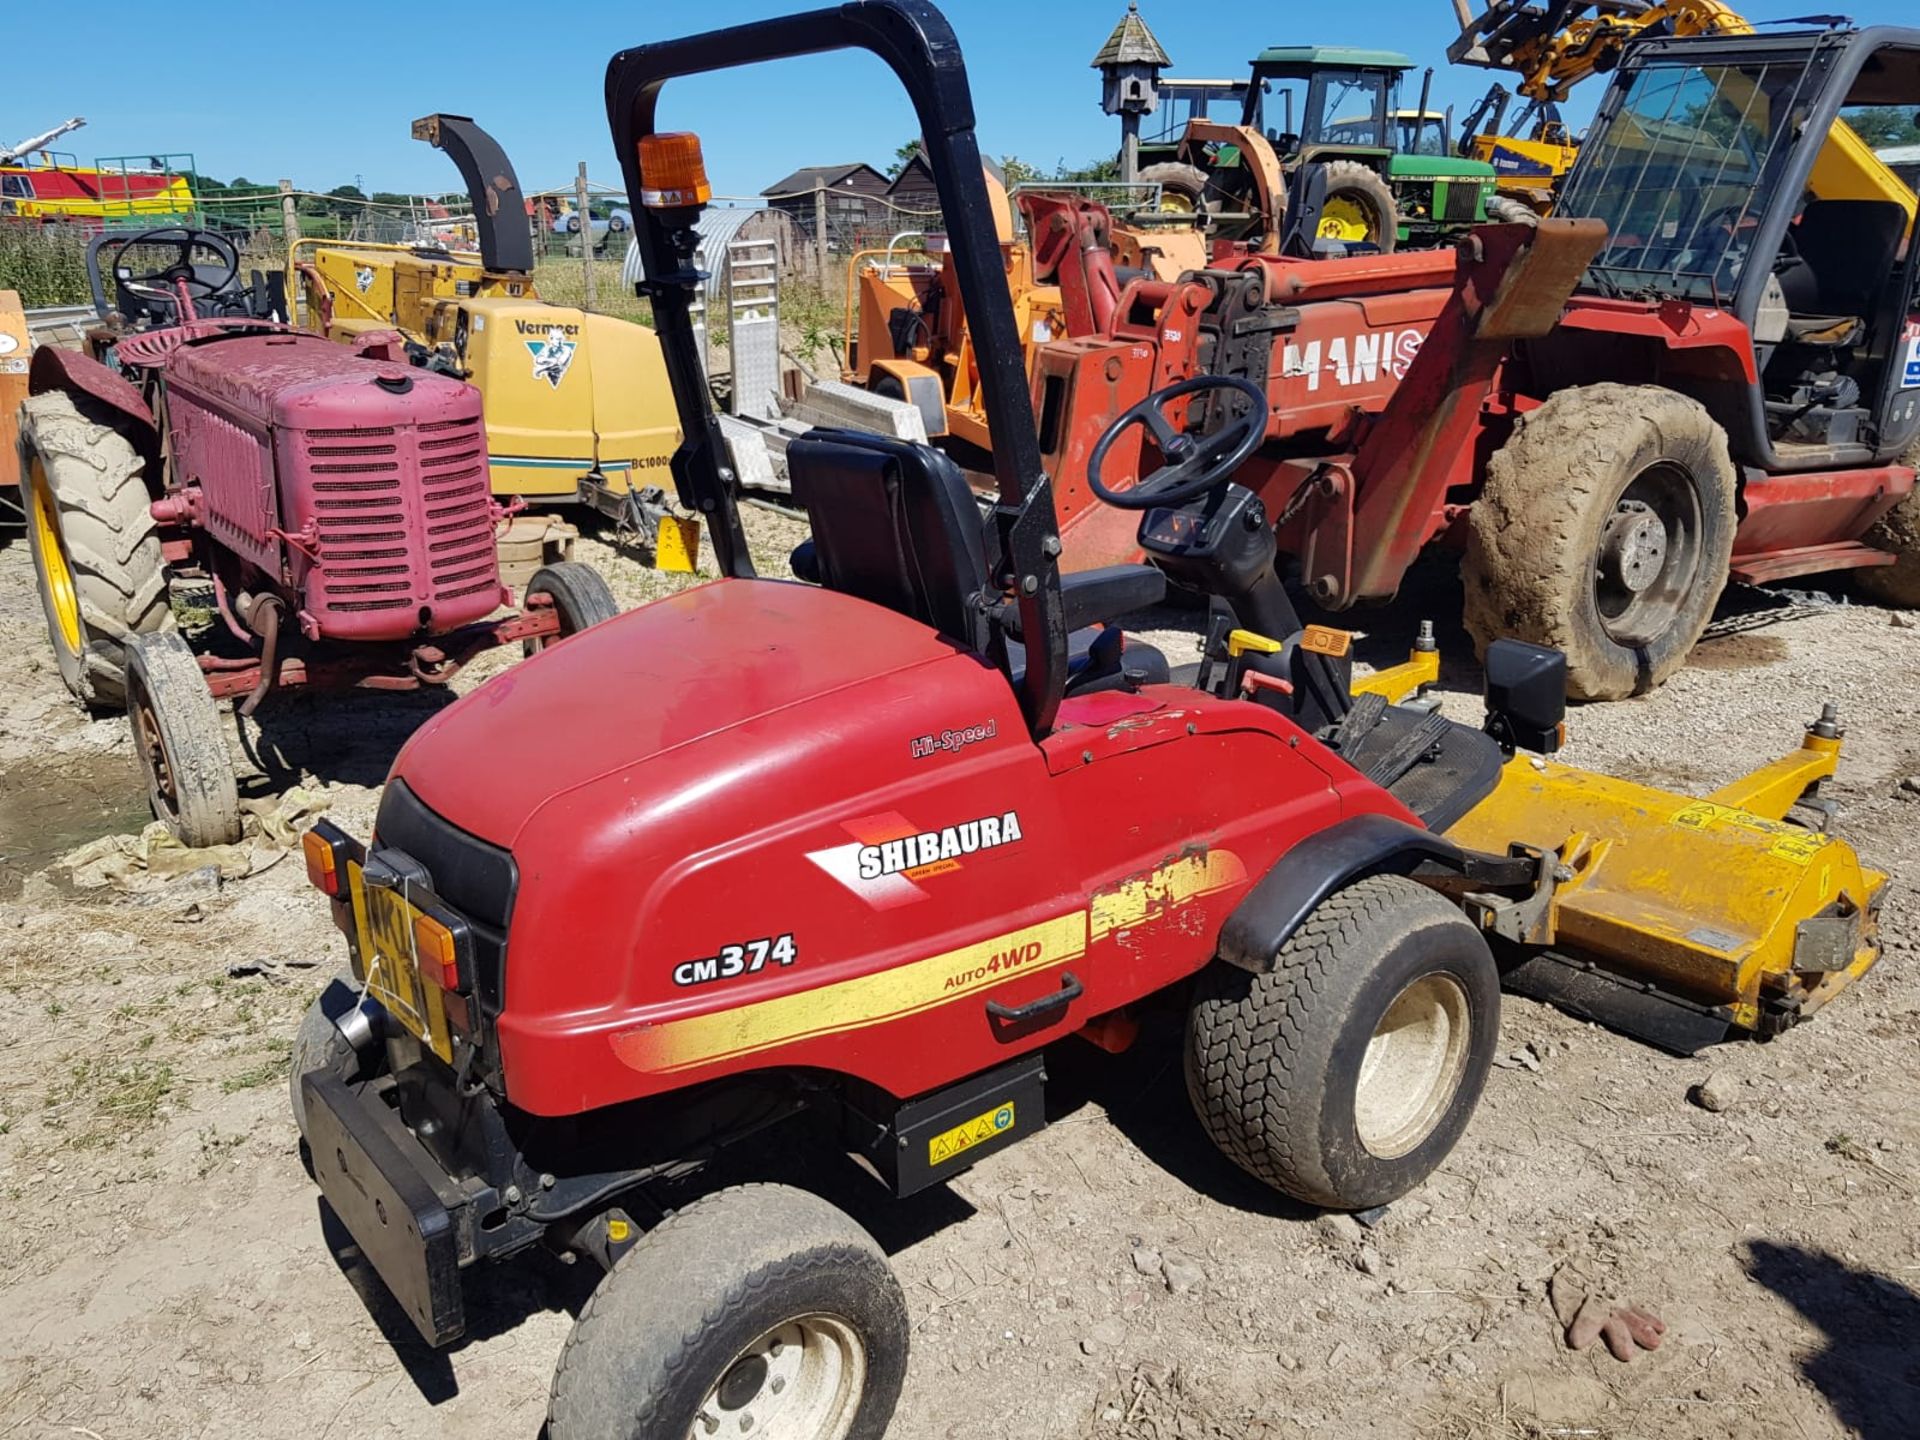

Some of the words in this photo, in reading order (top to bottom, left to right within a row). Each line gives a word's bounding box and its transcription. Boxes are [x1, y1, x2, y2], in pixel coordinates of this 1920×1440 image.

[514, 319, 579, 335] Vermeer
[1283, 329, 1429, 391] MANIS
[631, 455, 671, 469] BC1000
[910, 718, 997, 759] Hi-Speed
[858, 810, 1023, 880] SHIBAURA
[672, 932, 798, 987] CM374
